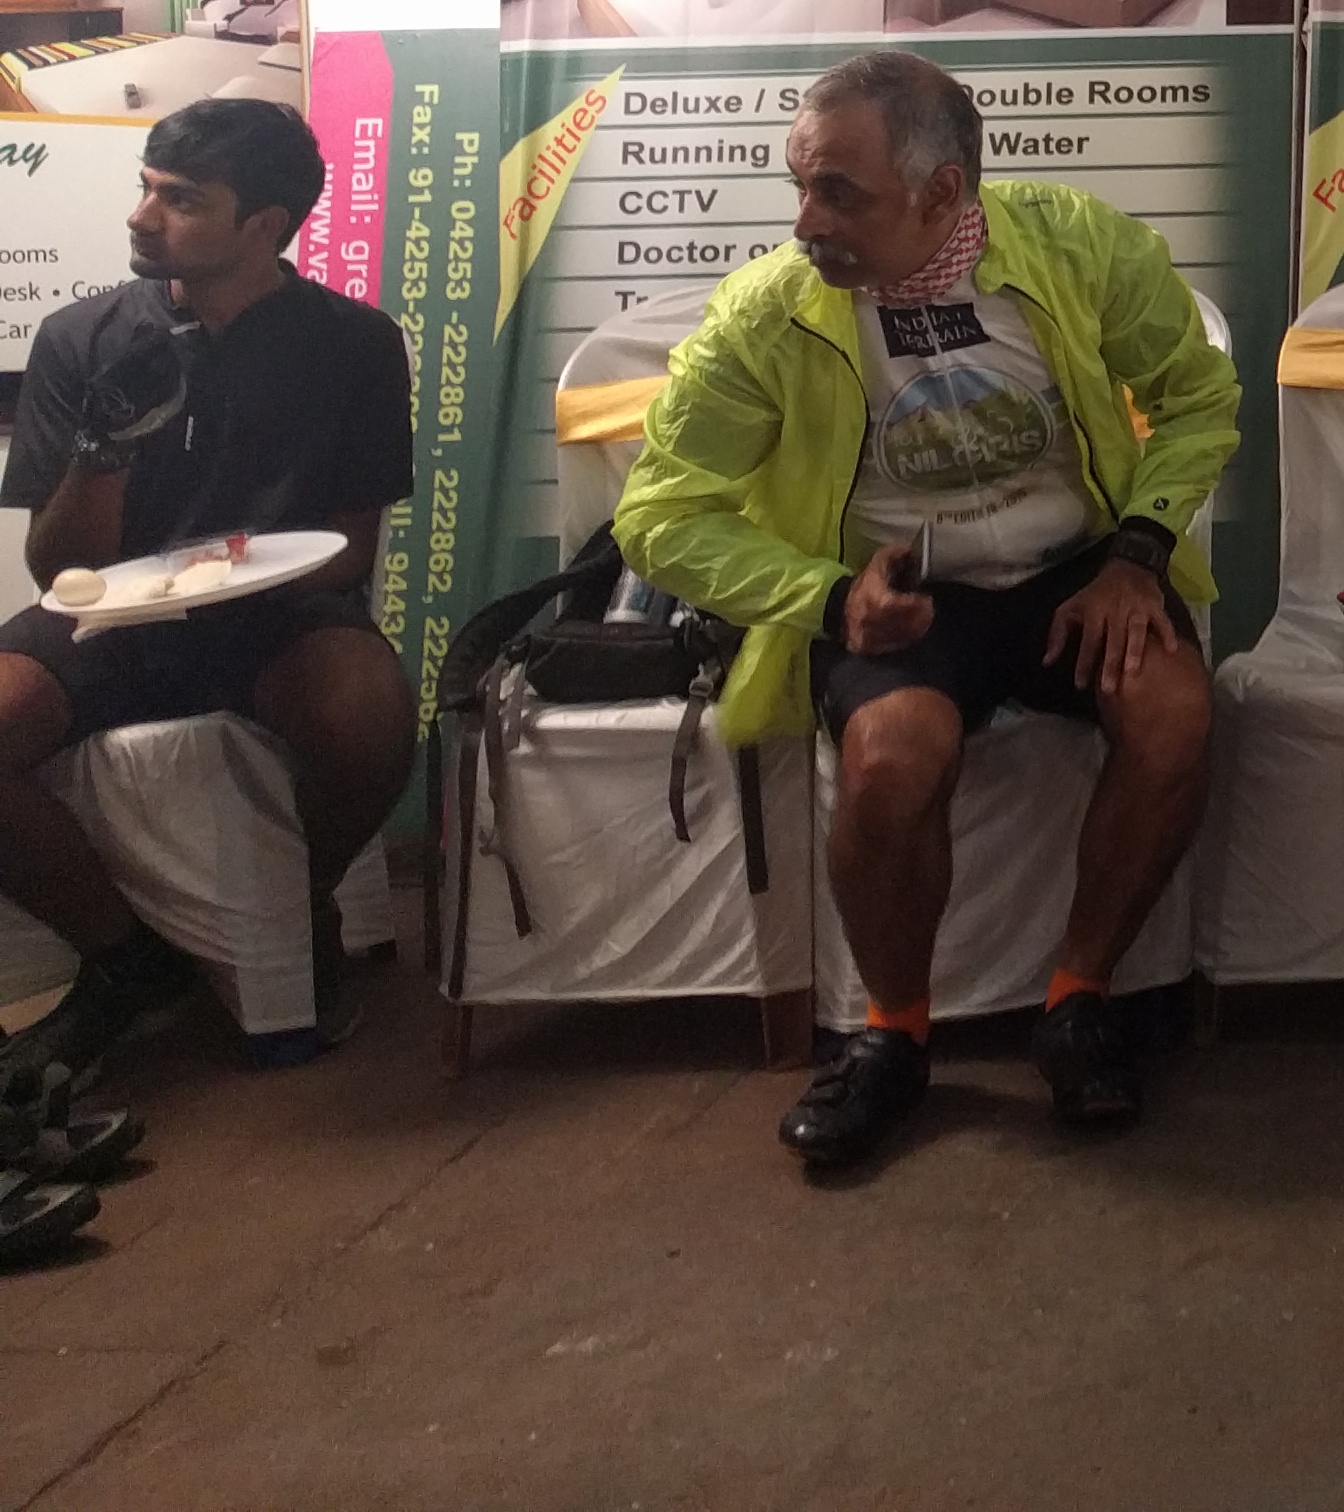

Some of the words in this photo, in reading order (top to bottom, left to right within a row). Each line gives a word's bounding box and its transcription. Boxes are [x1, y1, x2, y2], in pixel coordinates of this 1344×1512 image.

[411, 84, 439, 155] Fax:
[623, 90, 743, 115] Deluxe
[755, 88, 766, 113] /
[1088, 80, 1211, 105] Rooms
[349, 117, 384, 224] Email:
[452, 132, 479, 187] Ph:
[502, 85, 609, 242] Facilities
[621, 138, 771, 169] Running
[988, 131, 1090, 156] Water
[618, 188, 719, 215] CCTV
[445, 200, 476, 300] 04253
[617, 240, 737, 266] Doctor
